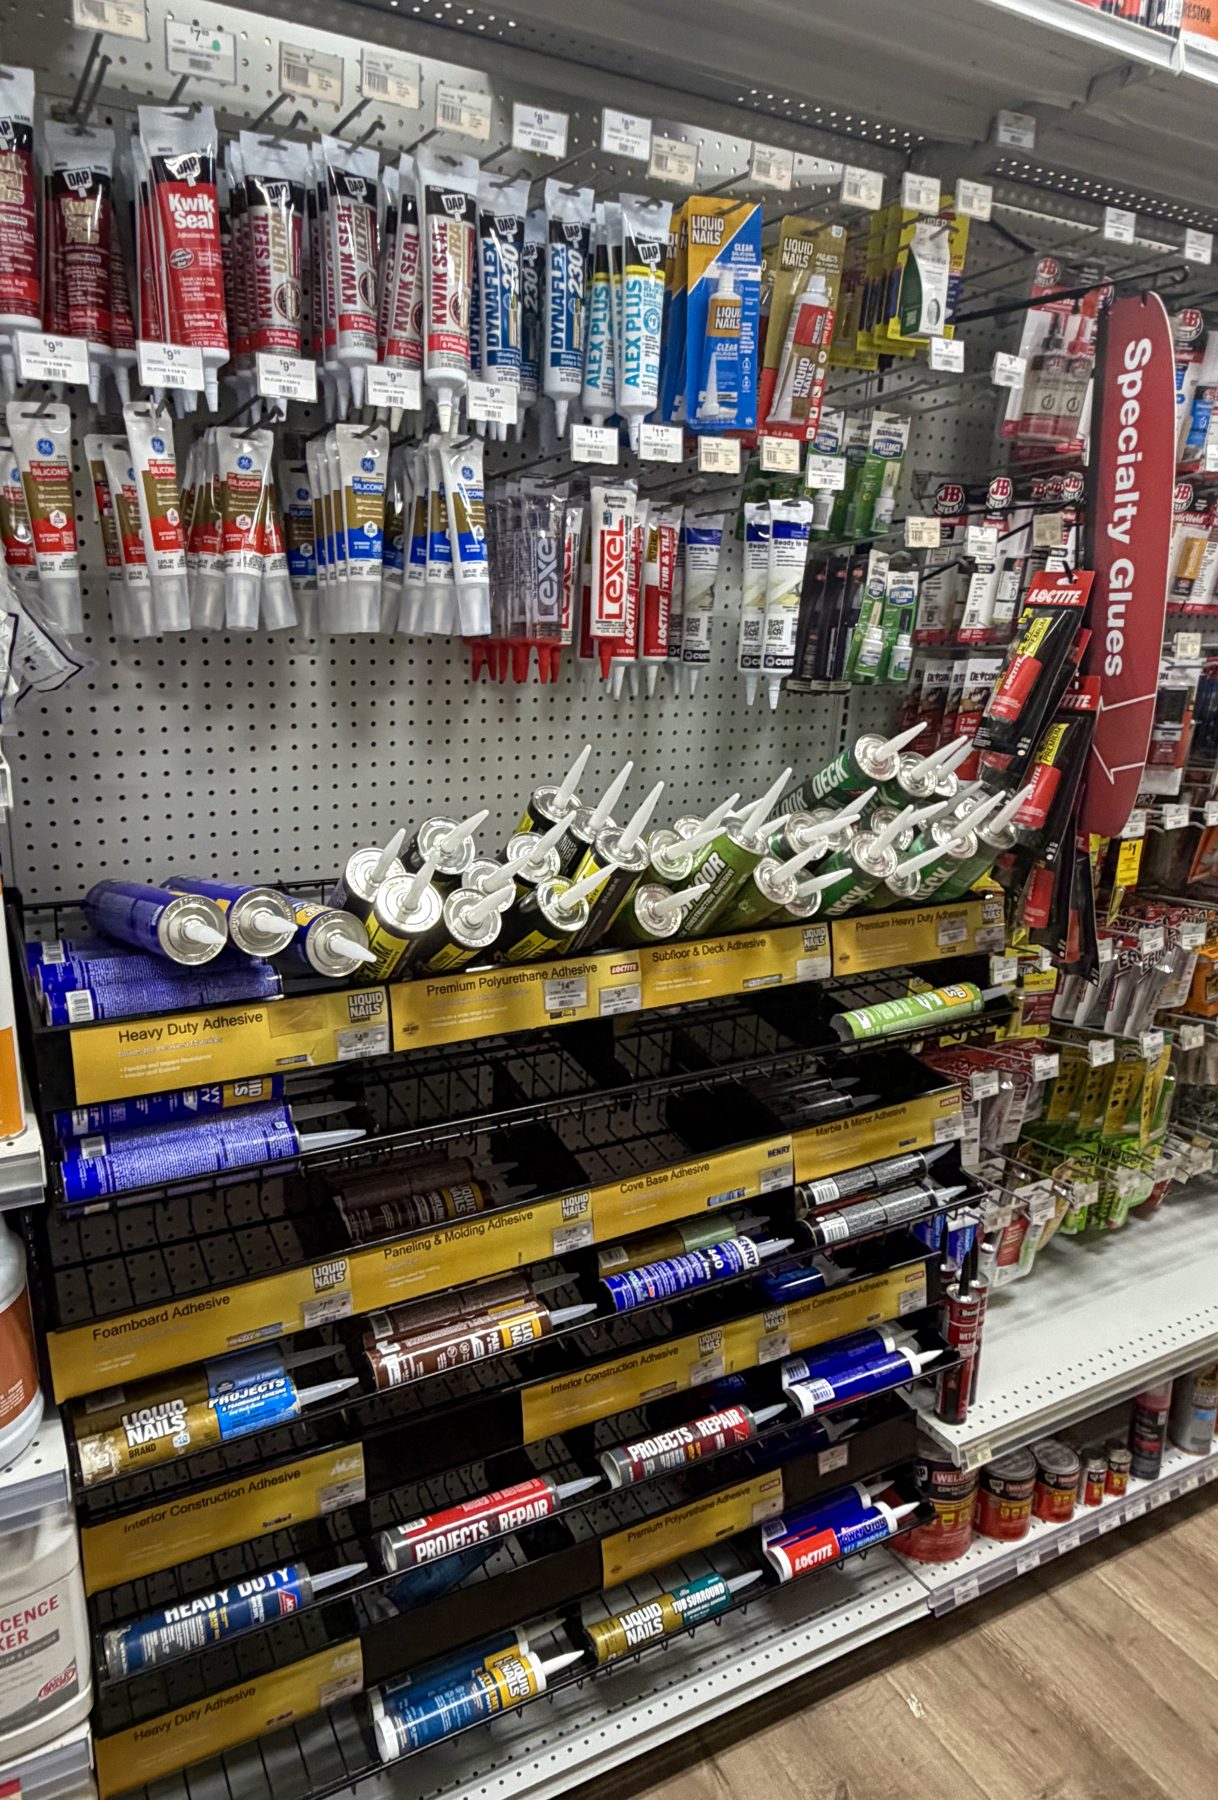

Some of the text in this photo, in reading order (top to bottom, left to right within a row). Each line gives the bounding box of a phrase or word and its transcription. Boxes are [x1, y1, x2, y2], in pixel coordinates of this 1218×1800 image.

[67, 169, 92, 186] DAP
[347, 178, 366, 194] DAP
[168, 193, 215, 213] Kwik
[445, 195, 464, 212] DAP
[174, 211, 214, 230] Seal
[497, 216, 516, 232] DAP
[565, 223, 581, 240] DAP
[691, 215, 725, 232] LIQUID
[270, 212, 287, 273] ULTRA
[691, 229, 722, 246] NAILS
[783, 237, 814, 256] LIQUID
[254, 212, 272, 320] KWIK SEAL
[336, 202, 357, 306] KWIK SEAL
[640, 245, 658, 261] DAP
[781, 251, 810, 269] NAILS
[393, 232, 420, 332] KWIK SEAL
[431, 222, 448, 325] KWIK SEAL
[500, 243, 520, 295] 230
[567, 249, 584, 299] 230
[483, 238, 500, 347] DYNAFLEX
[550, 243, 567, 350] DYNAFLEX
[586, 285, 609, 389] ALEX PLUS
[625, 278, 642, 388] ALEX PLUS
[715, 317, 741, 330] NAILS
[792, 356, 810, 398] LIQUID
[800, 362, 816, 398] NAILS
[873, 441, 903, 454] APPLIANCE
[31, 467, 70, 476] SILICONE
[1105, 337, 1153, 678] Specialty Glues
[658, 528, 671, 646] LOCTITE TUB TILE
[1028, 588, 1083, 604] LOCTITE
[625, 594, 637, 647] LOCTITE
[969, 671, 999, 682] DEVCON
[1004, 653, 1025, 691] LOCTITE
[811, 753, 849, 800] DECK
[802, 928, 826, 939] LIQUID
[855, 908, 968, 932] Premium Heavy Duty Adhesive
[651, 937, 766, 964] Subfloor & Deck Adhesive
[803, 936, 826, 947] NAILS
[426, 980, 476, 997] Premium
[479, 971, 549, 992] Polyurethane
[551, 963, 597, 979] Adhesive
[610, 963, 638, 975] LOCTITE
[348, 992, 384, 1007] LIQUID
[349, 1003, 382, 1018] NAILS
[118, 1012, 263, 1043] Heavy Duty Adhesive
[815, 1106, 907, 1137] Marble & Mirror Adhesive
[767, 1144, 791, 1158] HENRY
[619, 1161, 710, 1194] Cove Base Adhesive
[562, 1193, 589, 1208] LIQUID
[562, 1204, 588, 1218] NAILS
[383, 1211, 534, 1260] Paneling & Molding Adhesive
[312, 1260, 346, 1278] LIQUID
[707, 1248, 724, 1269] 440
[314, 1272, 346, 1288] NAILS
[812, 1278, 889, 1308] Construction Adhesive
[92, 1294, 231, 1341] Foamboard Adhesive
[763, 1307, 786, 1319] LIQUID
[765, 1316, 786, 1328] NAILS
[698, 1330, 723, 1342] LIQUID
[699, 1340, 722, 1352] NAILS
[550, 1346, 679, 1395] Interior Construction Adhesive
[208, 1378, 286, 1409] PROJECTS
[121, 1400, 187, 1430] LIQUID
[125, 1415, 188, 1447] NAILS
[626, 1408, 744, 1462] PROJECTS REPAIR
[128, 1443, 157, 1458] BRAND
[123, 1468, 302, 1534] Interior Construction Adhesive
[626, 1486, 751, 1543] Premium Polyurethane Adhesive
[415, 1499, 550, 1562] PROJECTS REPAIR
[863, 1516, 887, 1533] Grab
[794, 1544, 833, 1571] LOCTITE
[163, 1567, 289, 1624] HEAVY DUTY
[671, 1581, 726, 1614] TUB SURROUND
[619, 1602, 663, 1630] LIQUID
[625, 1617, 664, 1647] NAILS
[502, 1665, 520, 1698] NAILS
[510, 1658, 530, 1697] LIQUID
[132, 1685, 256, 1742] Heavy Duty Adhesive
